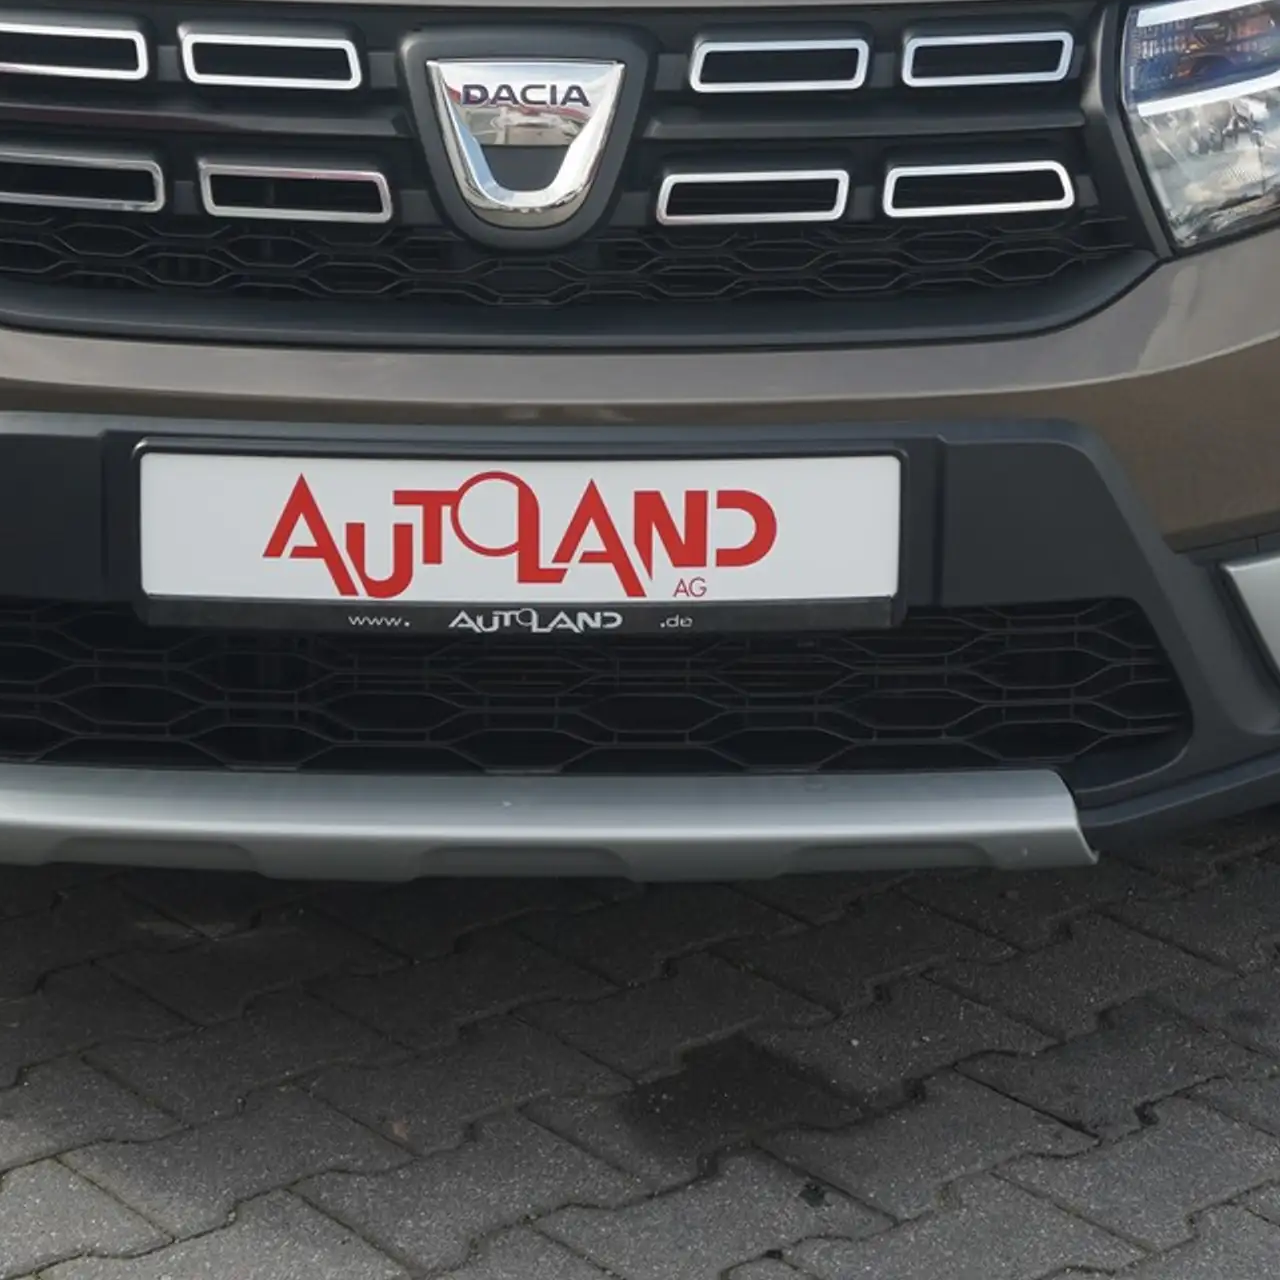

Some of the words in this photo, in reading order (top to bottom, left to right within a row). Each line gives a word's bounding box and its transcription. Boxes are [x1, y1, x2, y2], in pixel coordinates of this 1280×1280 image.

[461, 84, 590, 107] DACIA
[263, 471, 778, 599] AUTOLAND
[673, 577, 708, 598] AG
[448, 607, 623, 633] AUTOLAND
